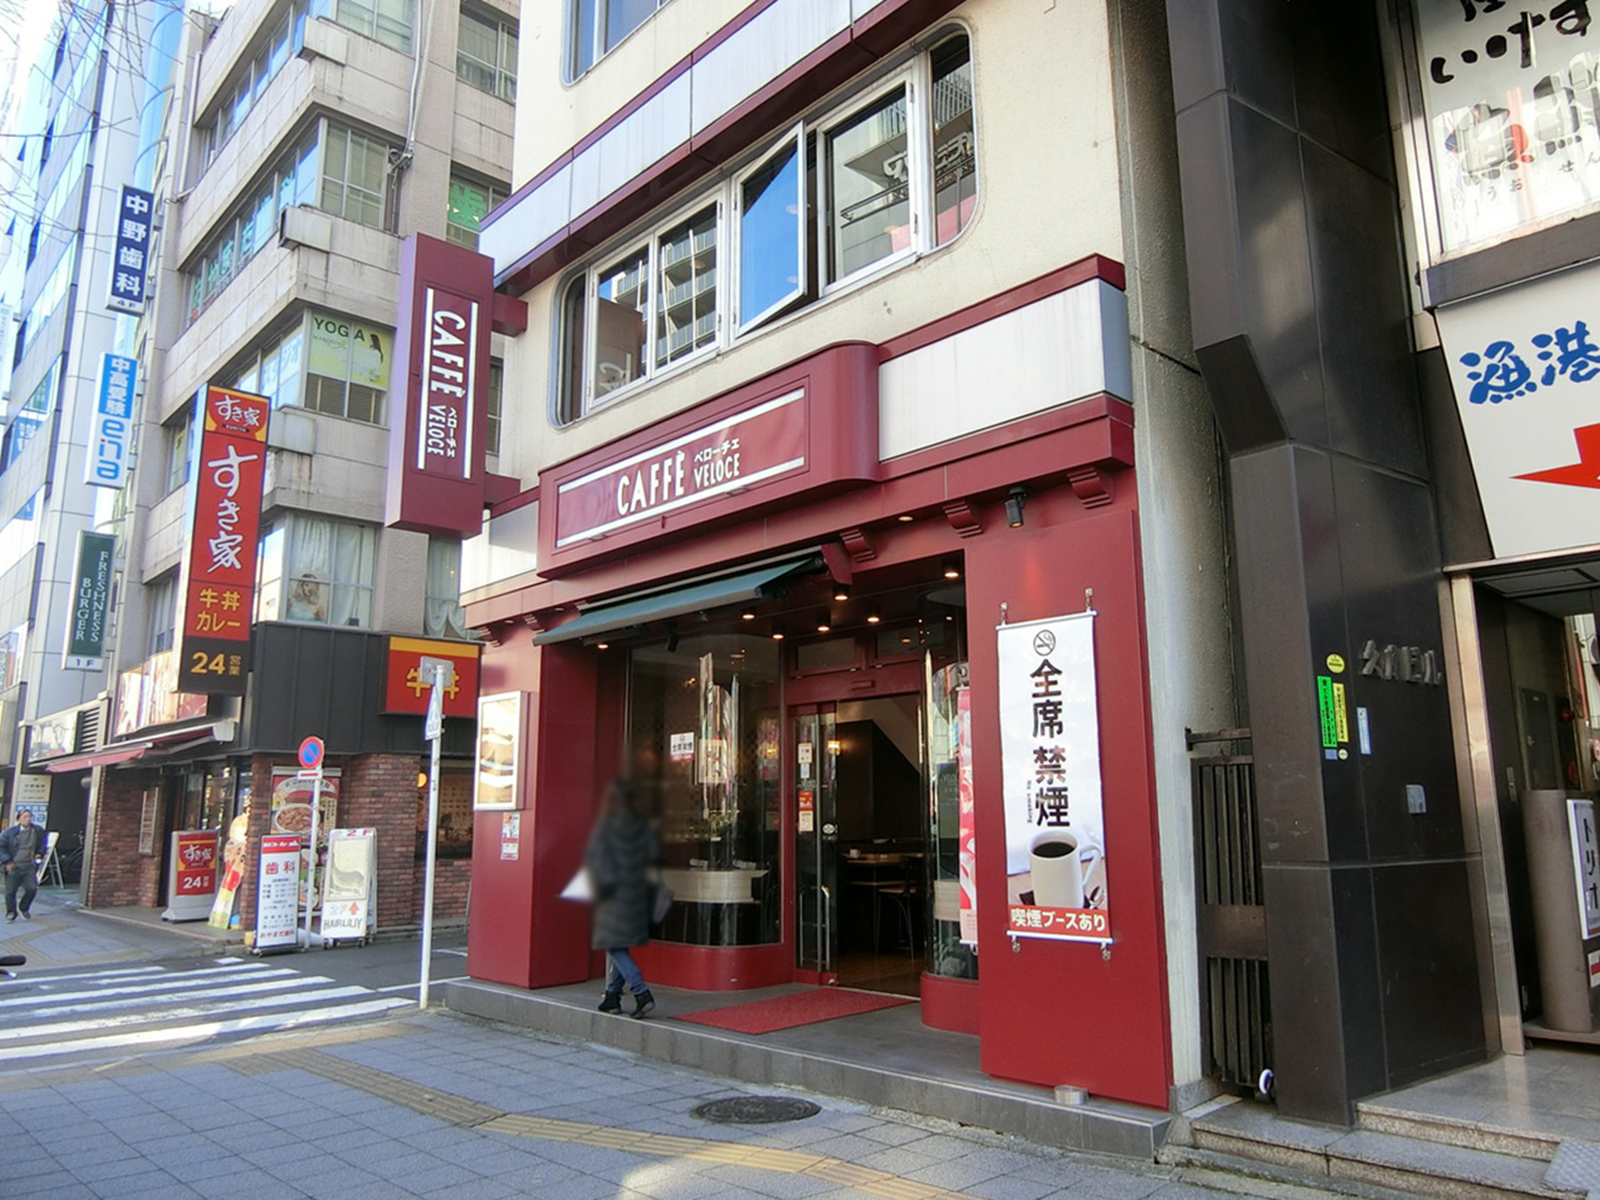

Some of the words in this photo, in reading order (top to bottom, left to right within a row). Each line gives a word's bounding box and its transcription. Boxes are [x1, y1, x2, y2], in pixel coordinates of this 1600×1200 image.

[115, 194, 149, 296] 中野歯科
[313, 316, 365, 342] YOGA
[1459, 320, 1600, 404] 漁港
[215, 395, 261, 428] すき家
[427, 404, 446, 457] VELOCE
[96, 418, 125, 480] ena
[694, 438, 740, 463] ベローチェ
[694, 452, 741, 489] VELOCE
[207, 445, 258, 573] すき家
[76, 577, 92, 641] BURGER
[90, 550, 109, 642] FRESHNESS
[199, 588, 241, 612] 牛丼
[196, 611, 241, 632] カレー
[190, 652, 226, 675] 24
[1030, 658, 1070, 828] 全席禁煙
[183, 844, 212, 862] すき家
[183, 876, 202, 889] 24
[1010, 907, 1106, 932] 喫煙ブースあり
